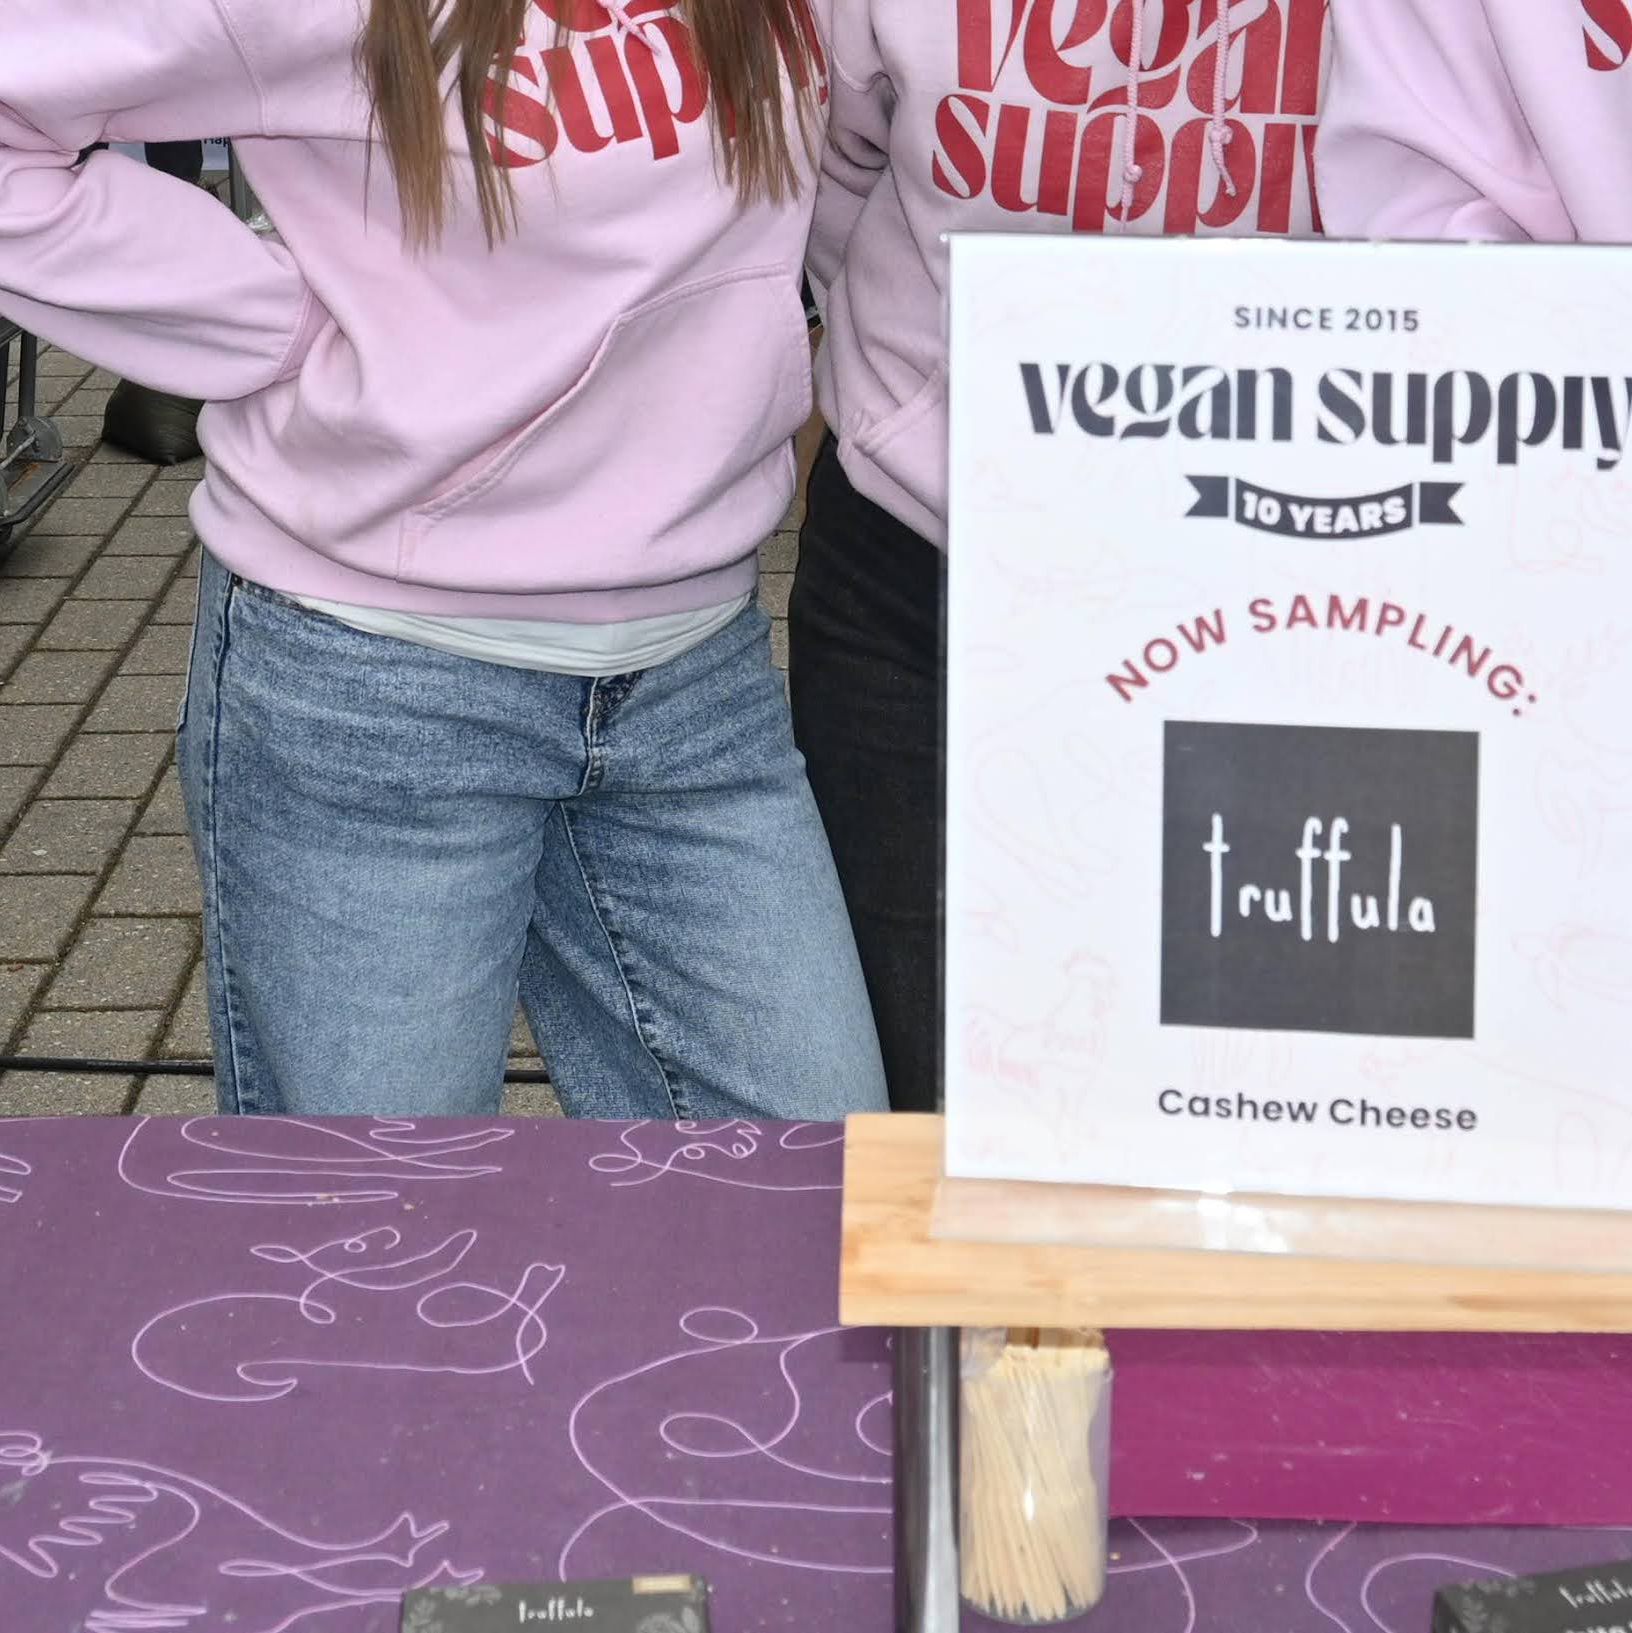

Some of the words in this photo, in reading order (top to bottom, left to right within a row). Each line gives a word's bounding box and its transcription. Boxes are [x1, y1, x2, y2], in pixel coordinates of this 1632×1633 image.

[1233, 306, 1335, 332] SINCE
[1344, 307, 1421, 332] 2015
[1019, 361, 1293, 442] vegan
[1242, 491, 1281, 526] 10
[1289, 495, 1407, 535] YEARS
[1105, 608, 1230, 704] NOW
[1248, 593, 1538, 718] SAMPLING:
[1203, 813, 1436, 944] truffula
[1157, 1088, 1318, 1124] Cashew
[1328, 1096, 1479, 1132] Cheese
